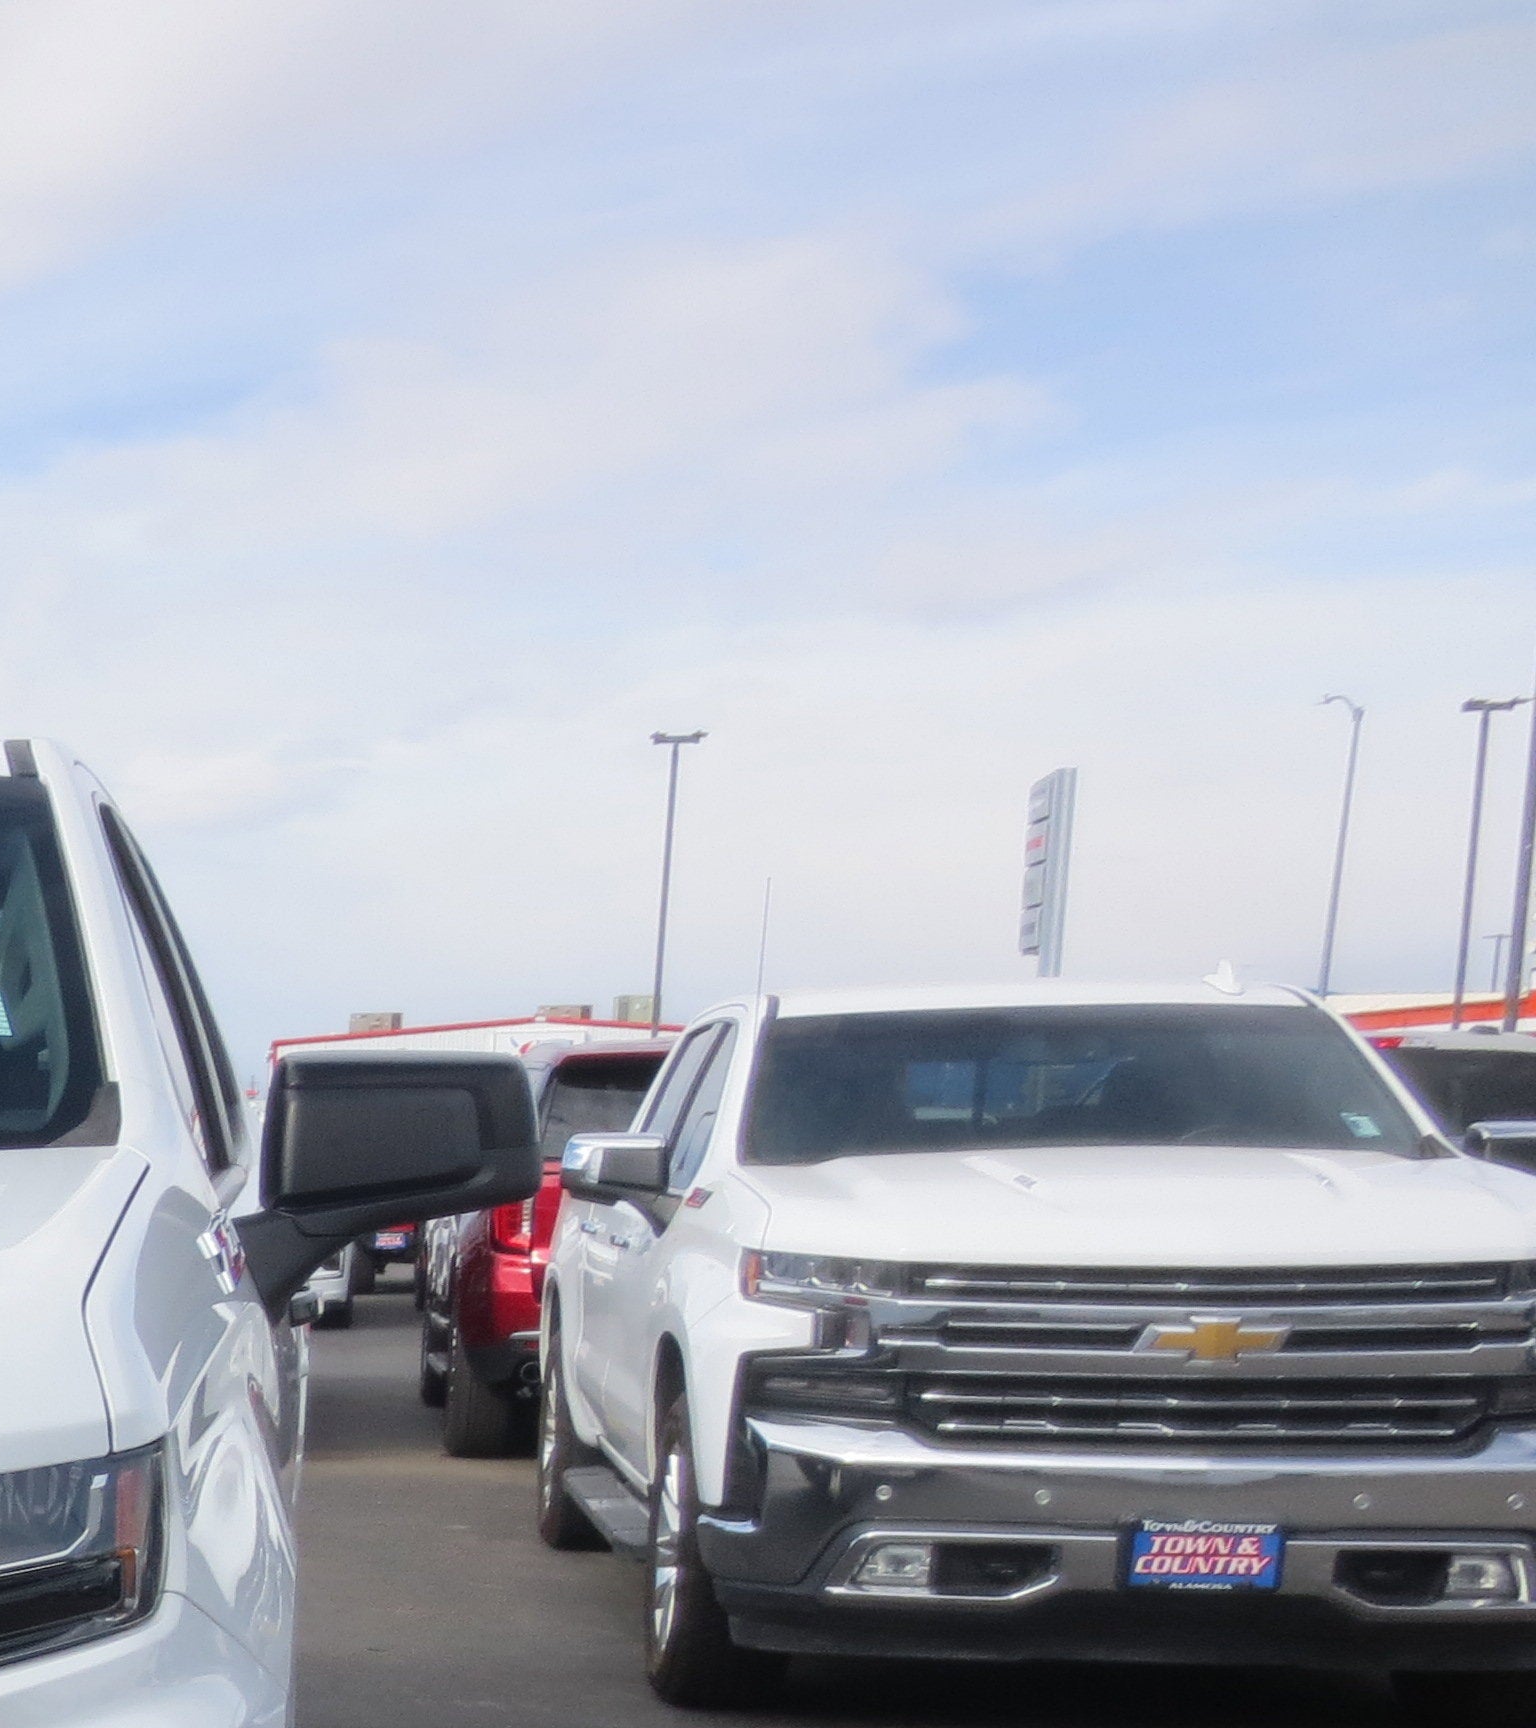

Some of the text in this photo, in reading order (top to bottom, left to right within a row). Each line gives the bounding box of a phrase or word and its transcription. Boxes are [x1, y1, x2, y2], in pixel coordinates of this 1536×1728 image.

[1150, 1535, 1261, 1555] TOWN &
[1134, 1555, 1272, 1575] COUNTRY
